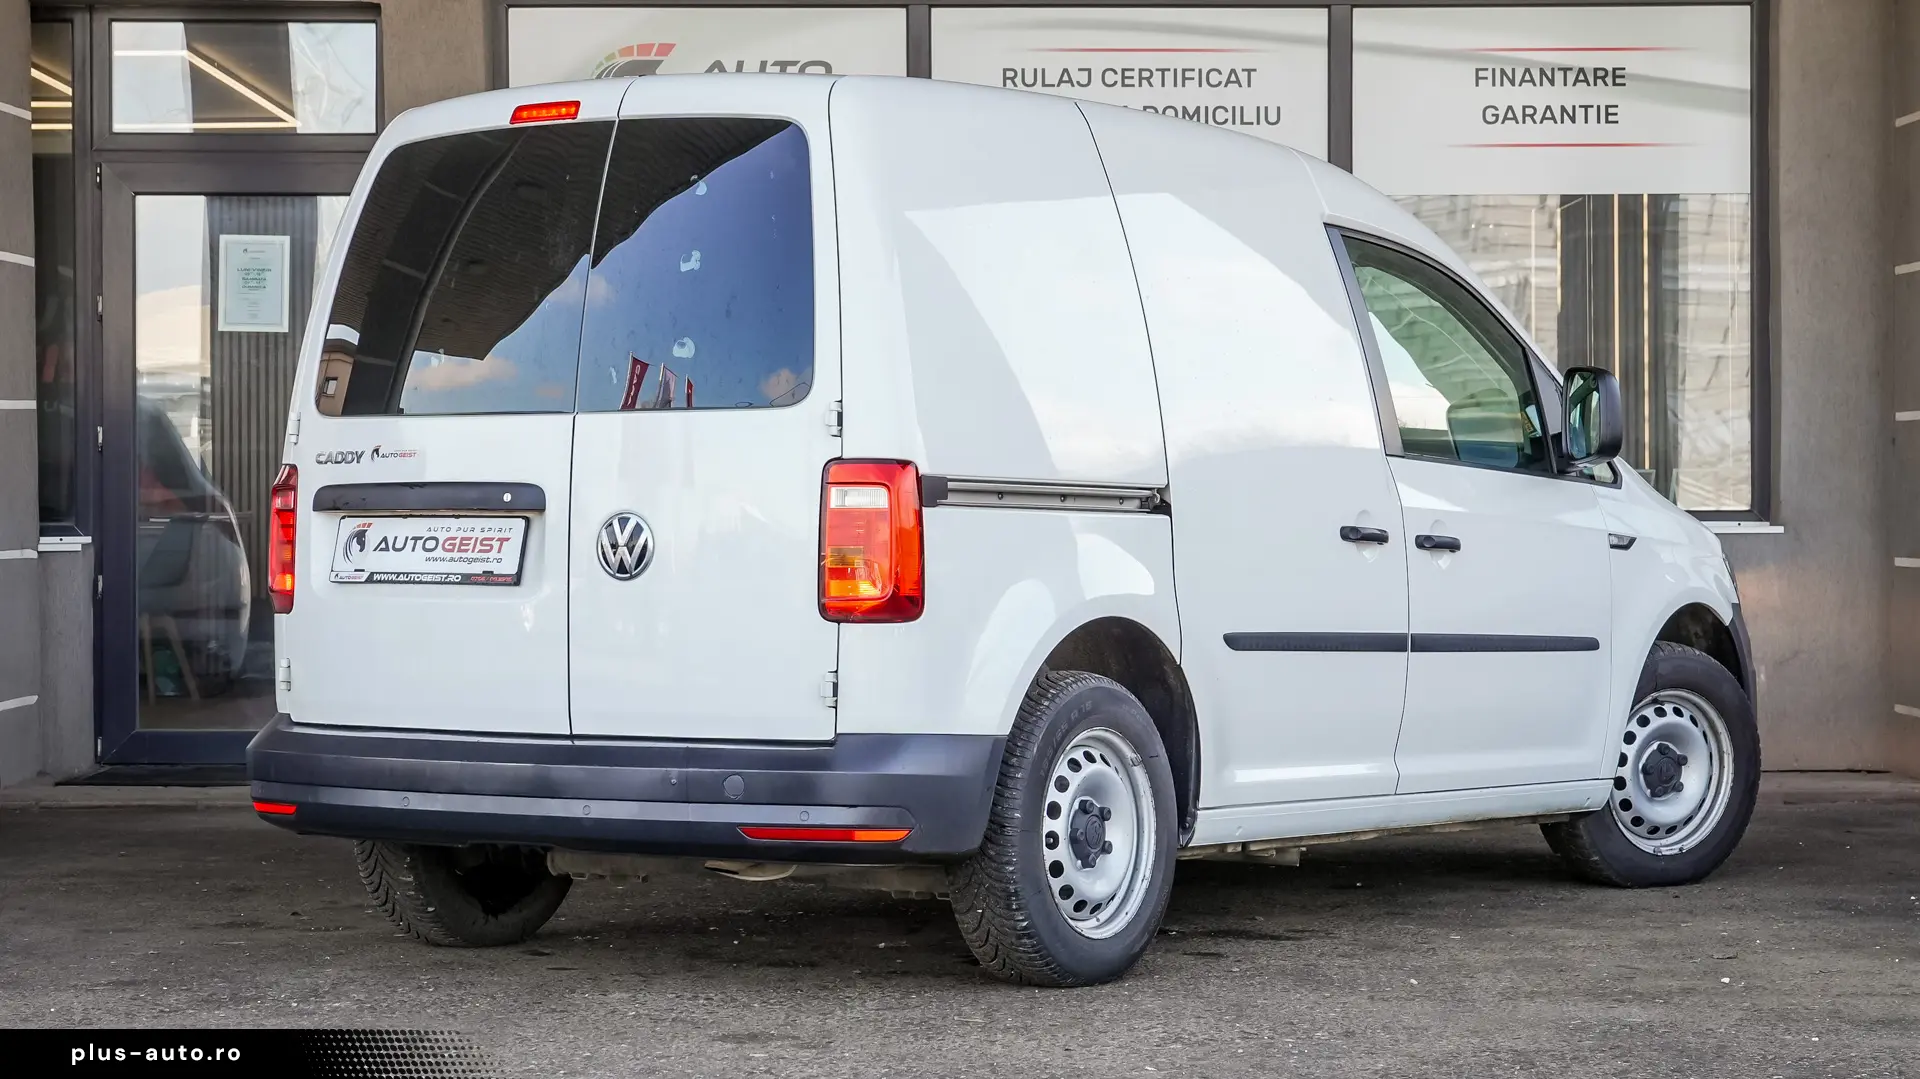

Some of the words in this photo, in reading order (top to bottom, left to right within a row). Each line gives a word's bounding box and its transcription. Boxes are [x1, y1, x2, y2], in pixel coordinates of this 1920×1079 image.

[1002, 67, 1093, 88] RULAJ
[1101, 67, 1258, 88] CERTIFICAT
[1474, 67, 1627, 88] FINANTARE
[1481, 104, 1620, 125] GARANTIE
[315, 450, 365, 465] CADDY
[425, 555, 503, 565] www.autogeist.ro
[373, 573, 462, 582] WWW.AUTOGEIST.RO
